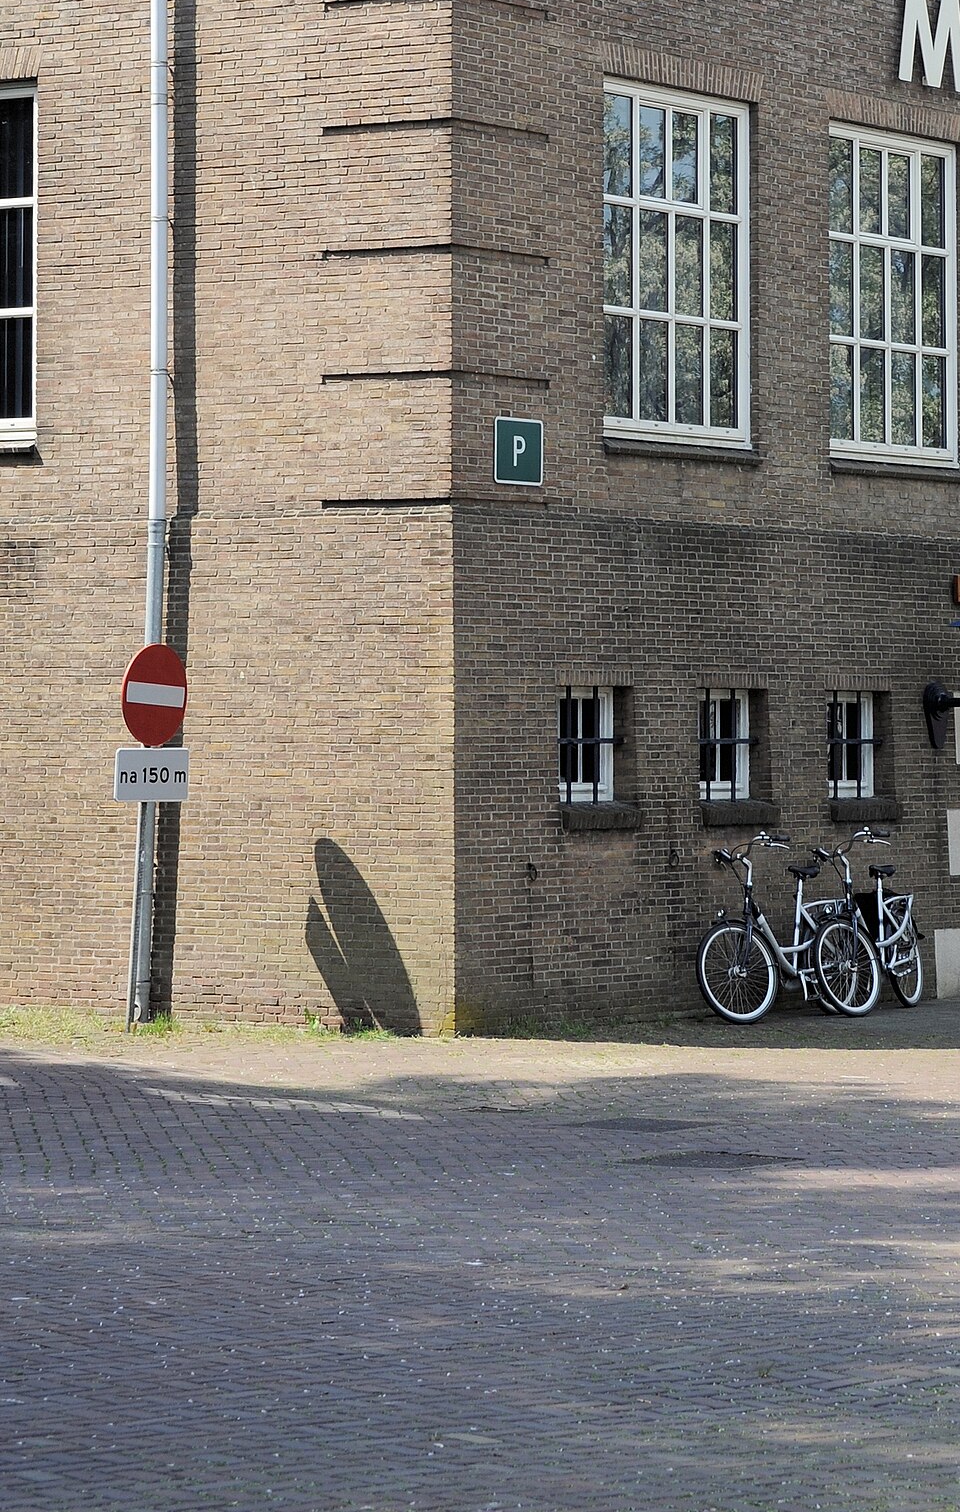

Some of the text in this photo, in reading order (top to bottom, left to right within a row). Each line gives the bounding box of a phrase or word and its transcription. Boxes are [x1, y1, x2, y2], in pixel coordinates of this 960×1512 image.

[513, 435, 526, 467] P
[120, 767, 186, 784] na 150 m
